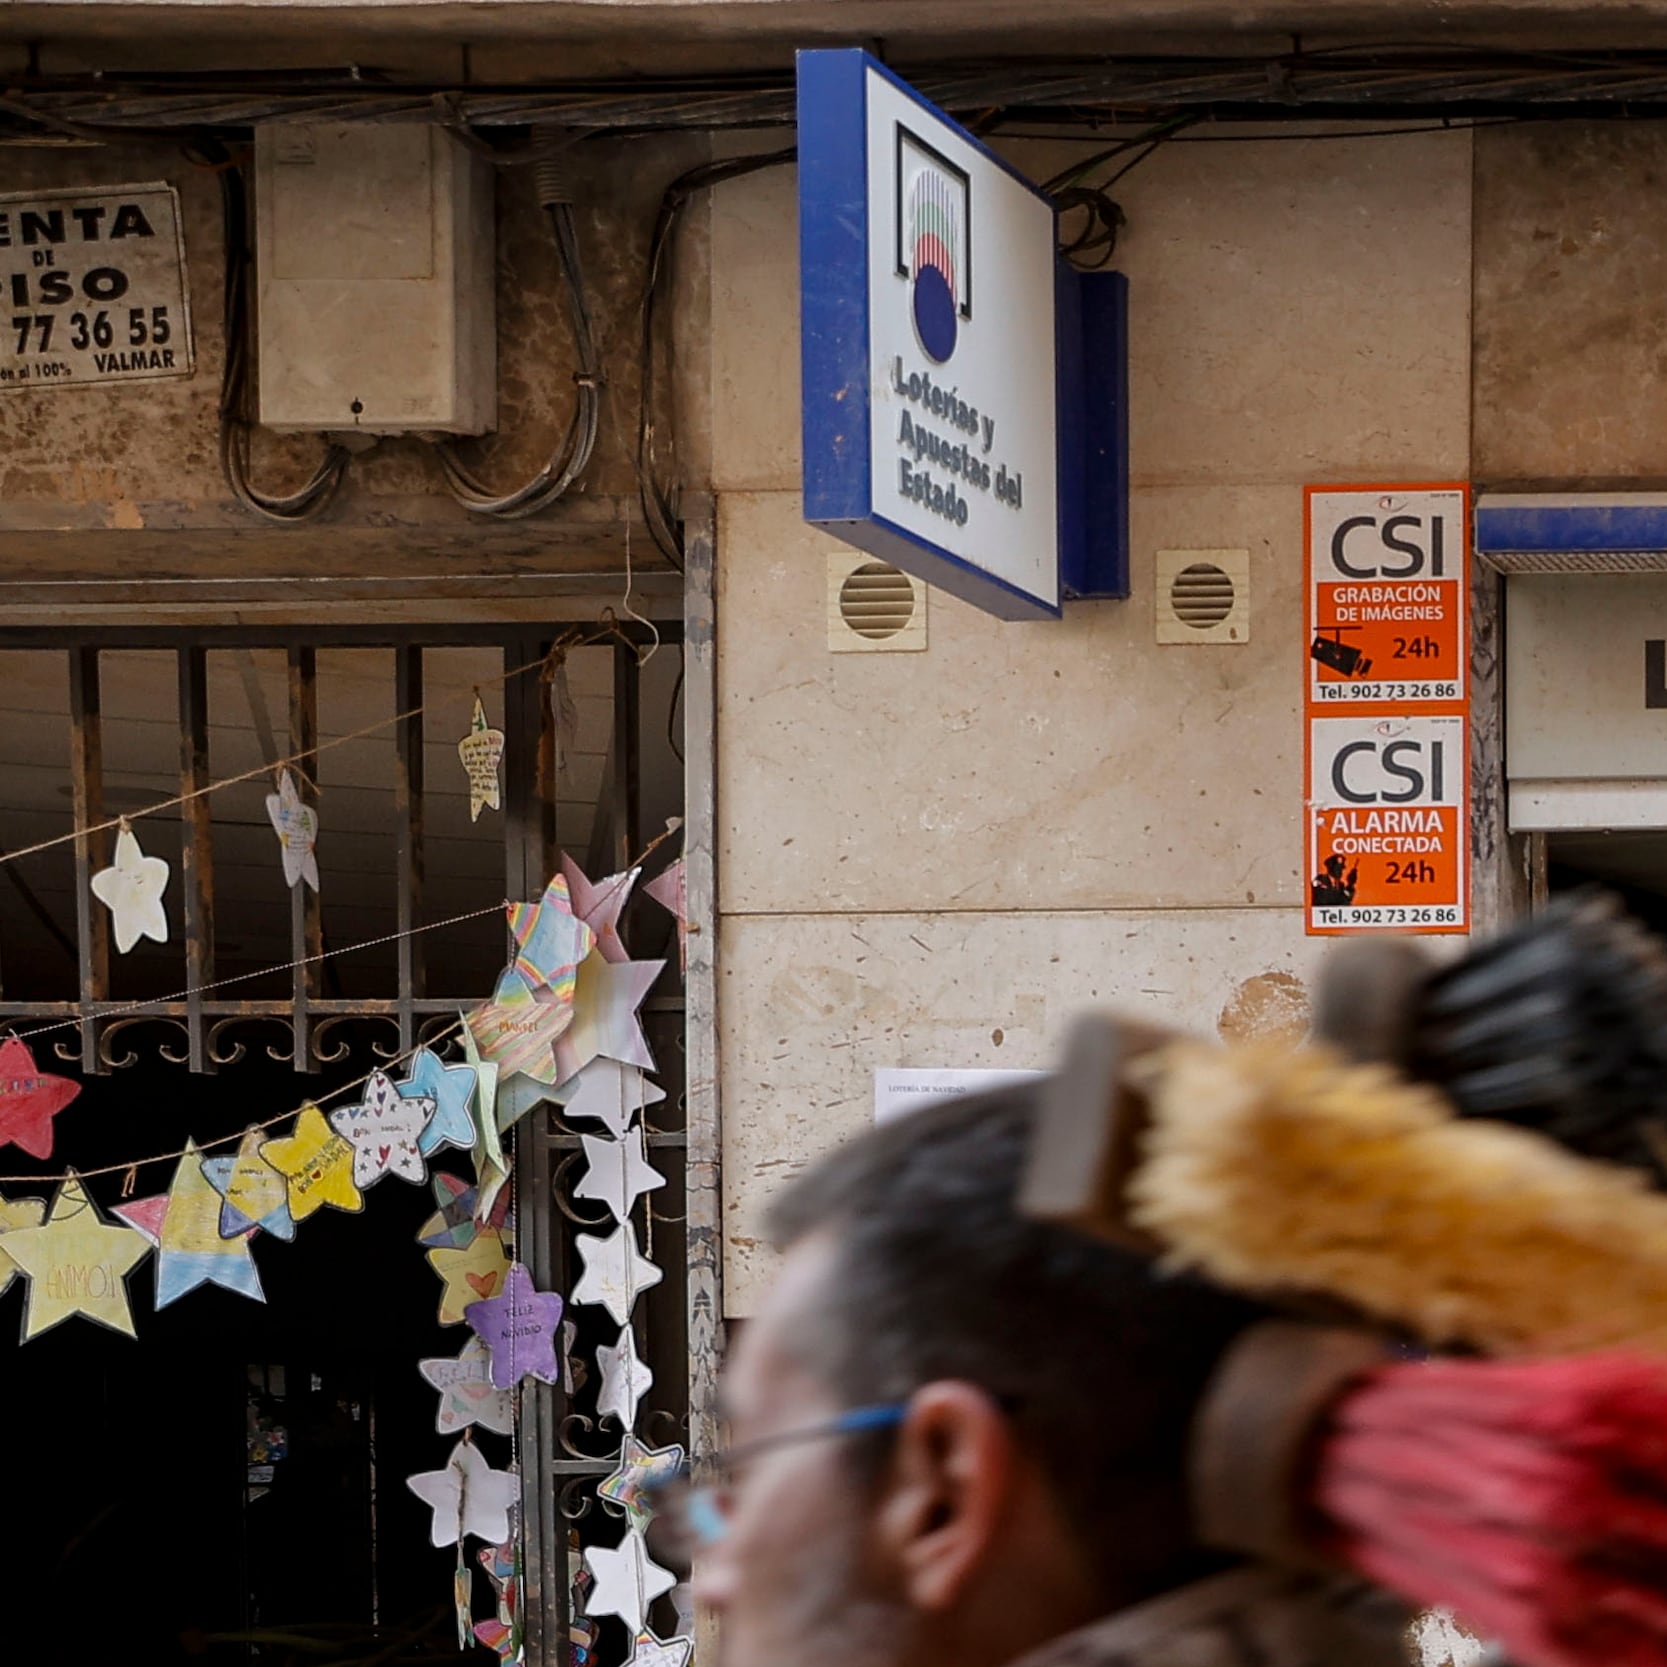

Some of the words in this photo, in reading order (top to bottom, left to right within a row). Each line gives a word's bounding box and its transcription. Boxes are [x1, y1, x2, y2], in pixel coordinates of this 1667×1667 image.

[32, 250, 55, 267] DE
[0, 267, 129, 308] ISO
[12, 314, 55, 355] 77
[70, 310, 114, 350] 36
[129, 306, 171, 346] 55
[94, 349, 176, 373] VALMAR
[890, 355, 980, 436] Loterías
[981, 414, 995, 454] y
[897, 408, 991, 491] Apuestas
[994, 463, 1023, 511] del
[897, 456, 969, 527] Estado
[1331, 515, 1444, 579] CSI
[1333, 584, 1441, 604] GRABACIÓN
[1336, 607, 1358, 621] DE
[1362, 604, 1444, 621] IMÁGENES
[1392, 635, 1439, 659] 24h
[1319, 684, 1347, 699] Tel.
[1351, 684, 1382, 699] 902
[1387, 684, 1407, 698] 73
[1410, 684, 1431, 698] 26
[1435, 683, 1456, 697] 86
[1331, 740, 1444, 804] CSI
[1330, 810, 1444, 834] ALARMA
[1332, 836, 1443, 854] CONECTADA
[1385, 860, 1435, 884] 24h
[1319, 909, 1347, 923] Tel.
[1352, 909, 1382, 923] 902
[1386, 909, 1407, 923] 73
[1411, 909, 1431, 923] 26
[1435, 908, 1456, 922] 86
